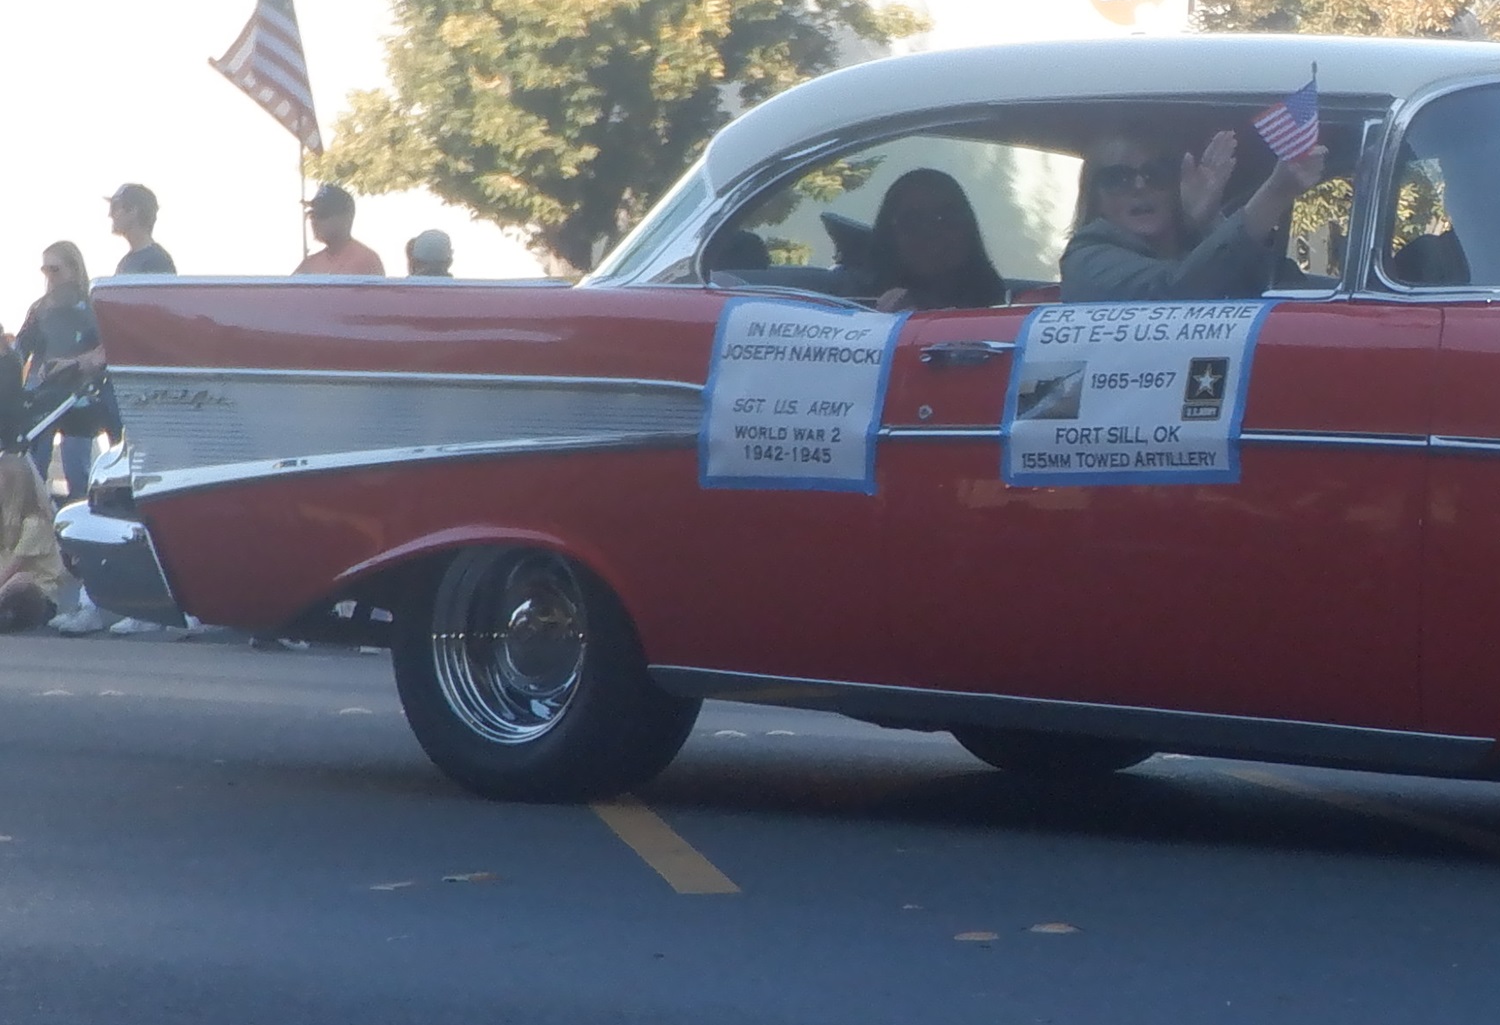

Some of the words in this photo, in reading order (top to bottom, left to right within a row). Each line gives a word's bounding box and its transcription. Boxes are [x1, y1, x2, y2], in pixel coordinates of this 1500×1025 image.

[1038, 309, 1075, 324] E.R.
[1085, 307, 1148, 322] "GUS"
[1149, 307, 1179, 321] ST.
[1184, 305, 1258, 320] MARIE
[747, 321, 766, 338] IN
[768, 322, 843, 340] MEMORY
[844, 328, 872, 341] OF
[1040, 327, 1087, 344] SGT
[1089, 325, 1130, 342] E-5
[1134, 324, 1170, 341] U.S.
[1176, 323, 1238, 341] ARMY
[722, 344, 786, 362] JOSEPH
[790, 347, 881, 365] NAWROCKI
[1091, 372, 1177, 389] 1965-1967
[807, 401, 855, 416] ARMY
[735, 426, 788, 440] WORLD
[794, 428, 825, 441] WAR
[831, 429, 841, 442] 2
[1055, 427, 1105, 444] FORT
[1107, 427, 1149, 445] SILL,
[1153, 426, 1182, 443] OK
[744, 445, 832, 464] 1942-1945
[1021, 453, 1071, 469] 155MM
[1075, 452, 1130, 468] TOWED
[1134, 451, 1217, 468] ARTILLERY
